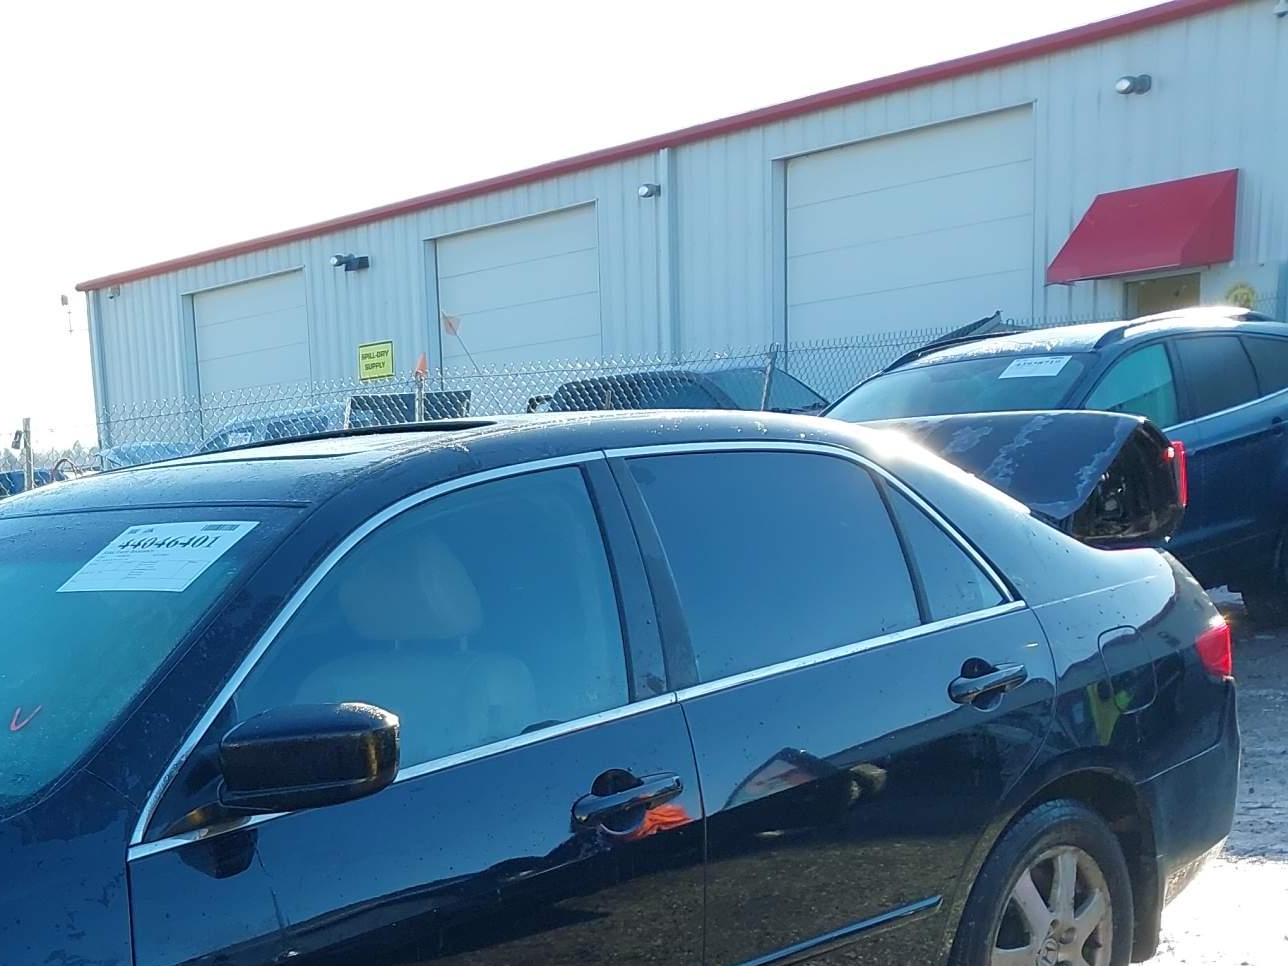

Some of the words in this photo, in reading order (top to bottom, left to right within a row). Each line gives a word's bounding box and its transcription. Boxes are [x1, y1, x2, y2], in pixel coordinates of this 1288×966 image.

[361, 350, 389, 360] SPILL-DRY
[364, 361, 386, 371] SUPPLY
[118, 535, 222, 549] 44046401
